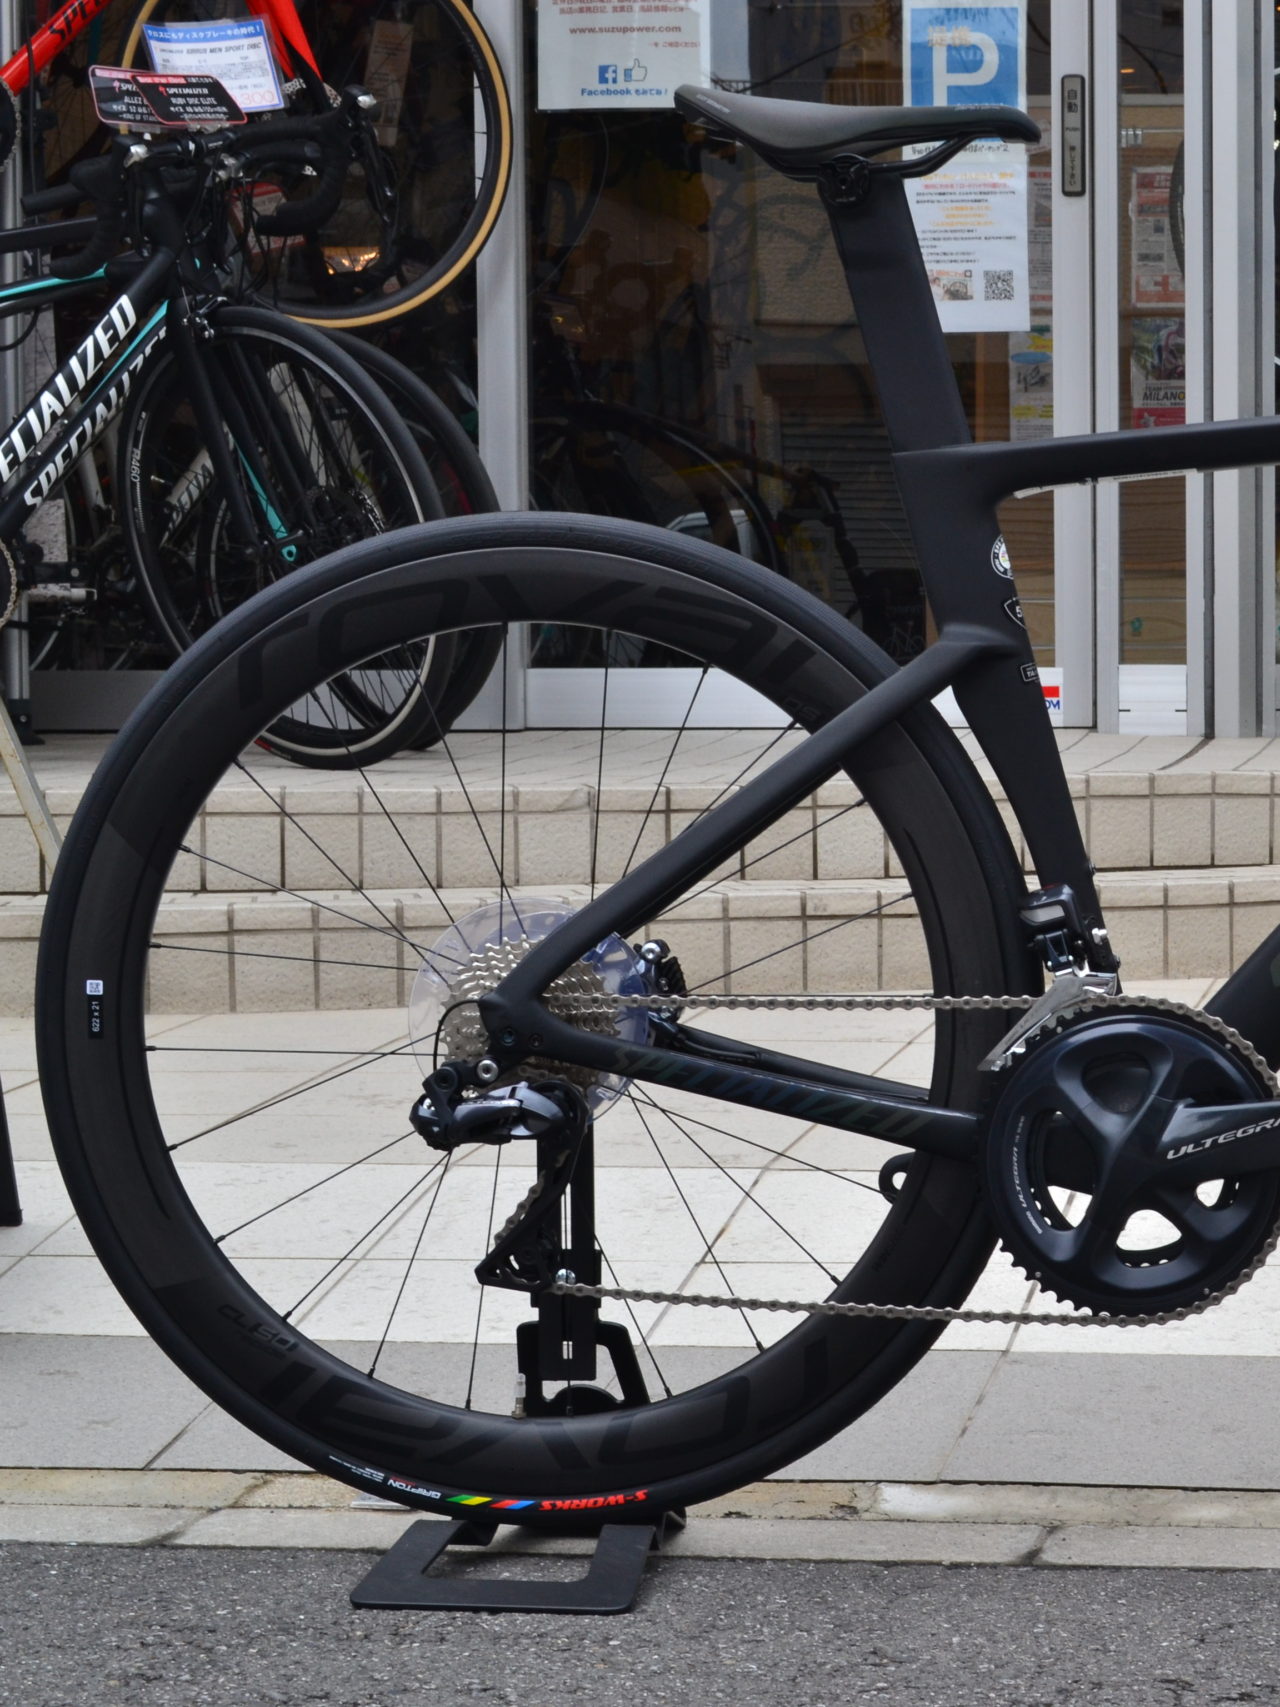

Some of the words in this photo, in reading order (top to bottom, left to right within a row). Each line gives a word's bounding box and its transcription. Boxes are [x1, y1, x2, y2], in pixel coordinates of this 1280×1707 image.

[569, 25, 682, 35] www.suzupower.com
[933, 32, 999, 107] P
[581, 88, 632, 97] Facebook
[92, 1018, 100, 1032] 622
[387, 1479, 442, 1499] GRIPTON
[538, 1489, 651, 1512] S-WORKS
